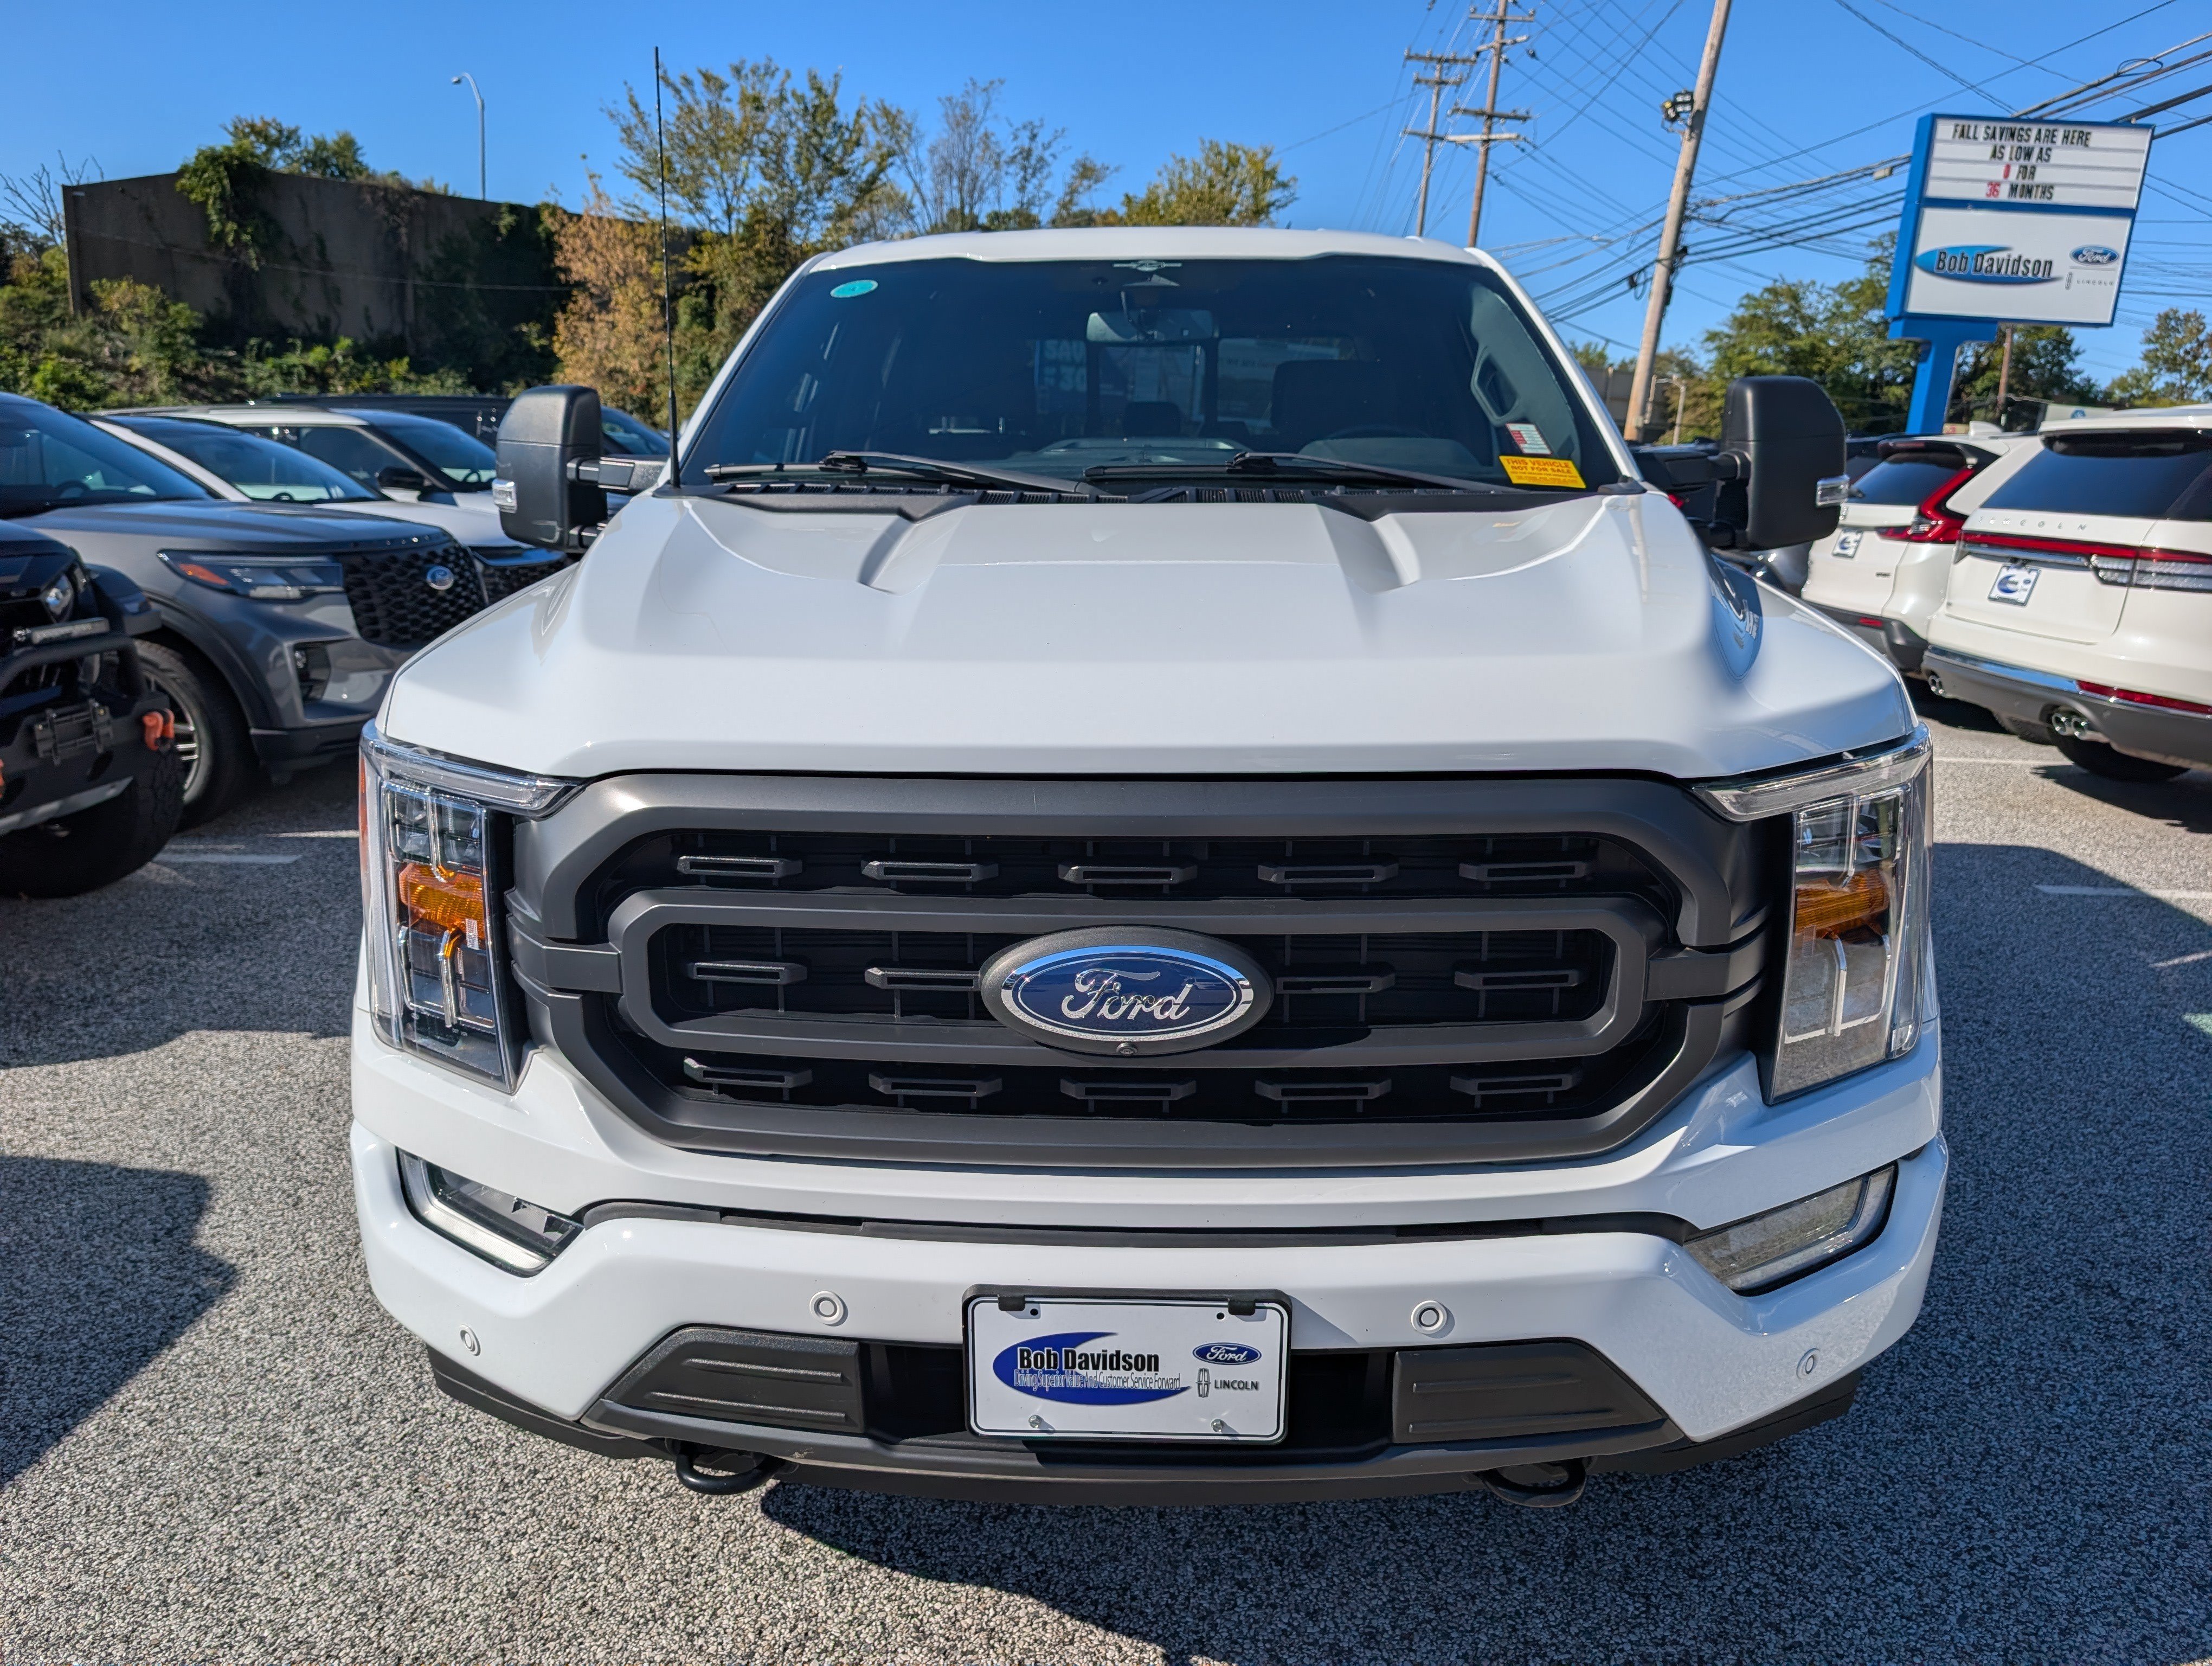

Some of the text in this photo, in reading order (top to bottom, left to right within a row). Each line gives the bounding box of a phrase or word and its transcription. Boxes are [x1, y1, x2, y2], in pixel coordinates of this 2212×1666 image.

[1952, 123, 2092, 148] FALL SAVINGS ARE HERE
[1990, 144, 2053, 163] AS LOW AS
[2002, 164, 2036, 181] 0 FOR
[1985, 182, 2055, 200] 36 MONTHS
[1935, 249, 2053, 279] Bob Davidson
[1504, 458, 1571, 468] THIS VEHICLE
[1061, 968, 1193, 1020] Ford
[1018, 1347, 1159, 1372] Bob Davidson
[1206, 1345, 1249, 1361] Ford
[1014, 1369, 1180, 1392] Driving Superior Value And Customer Service Forward
[1214, 1379, 1259, 1391] LINCOLN
